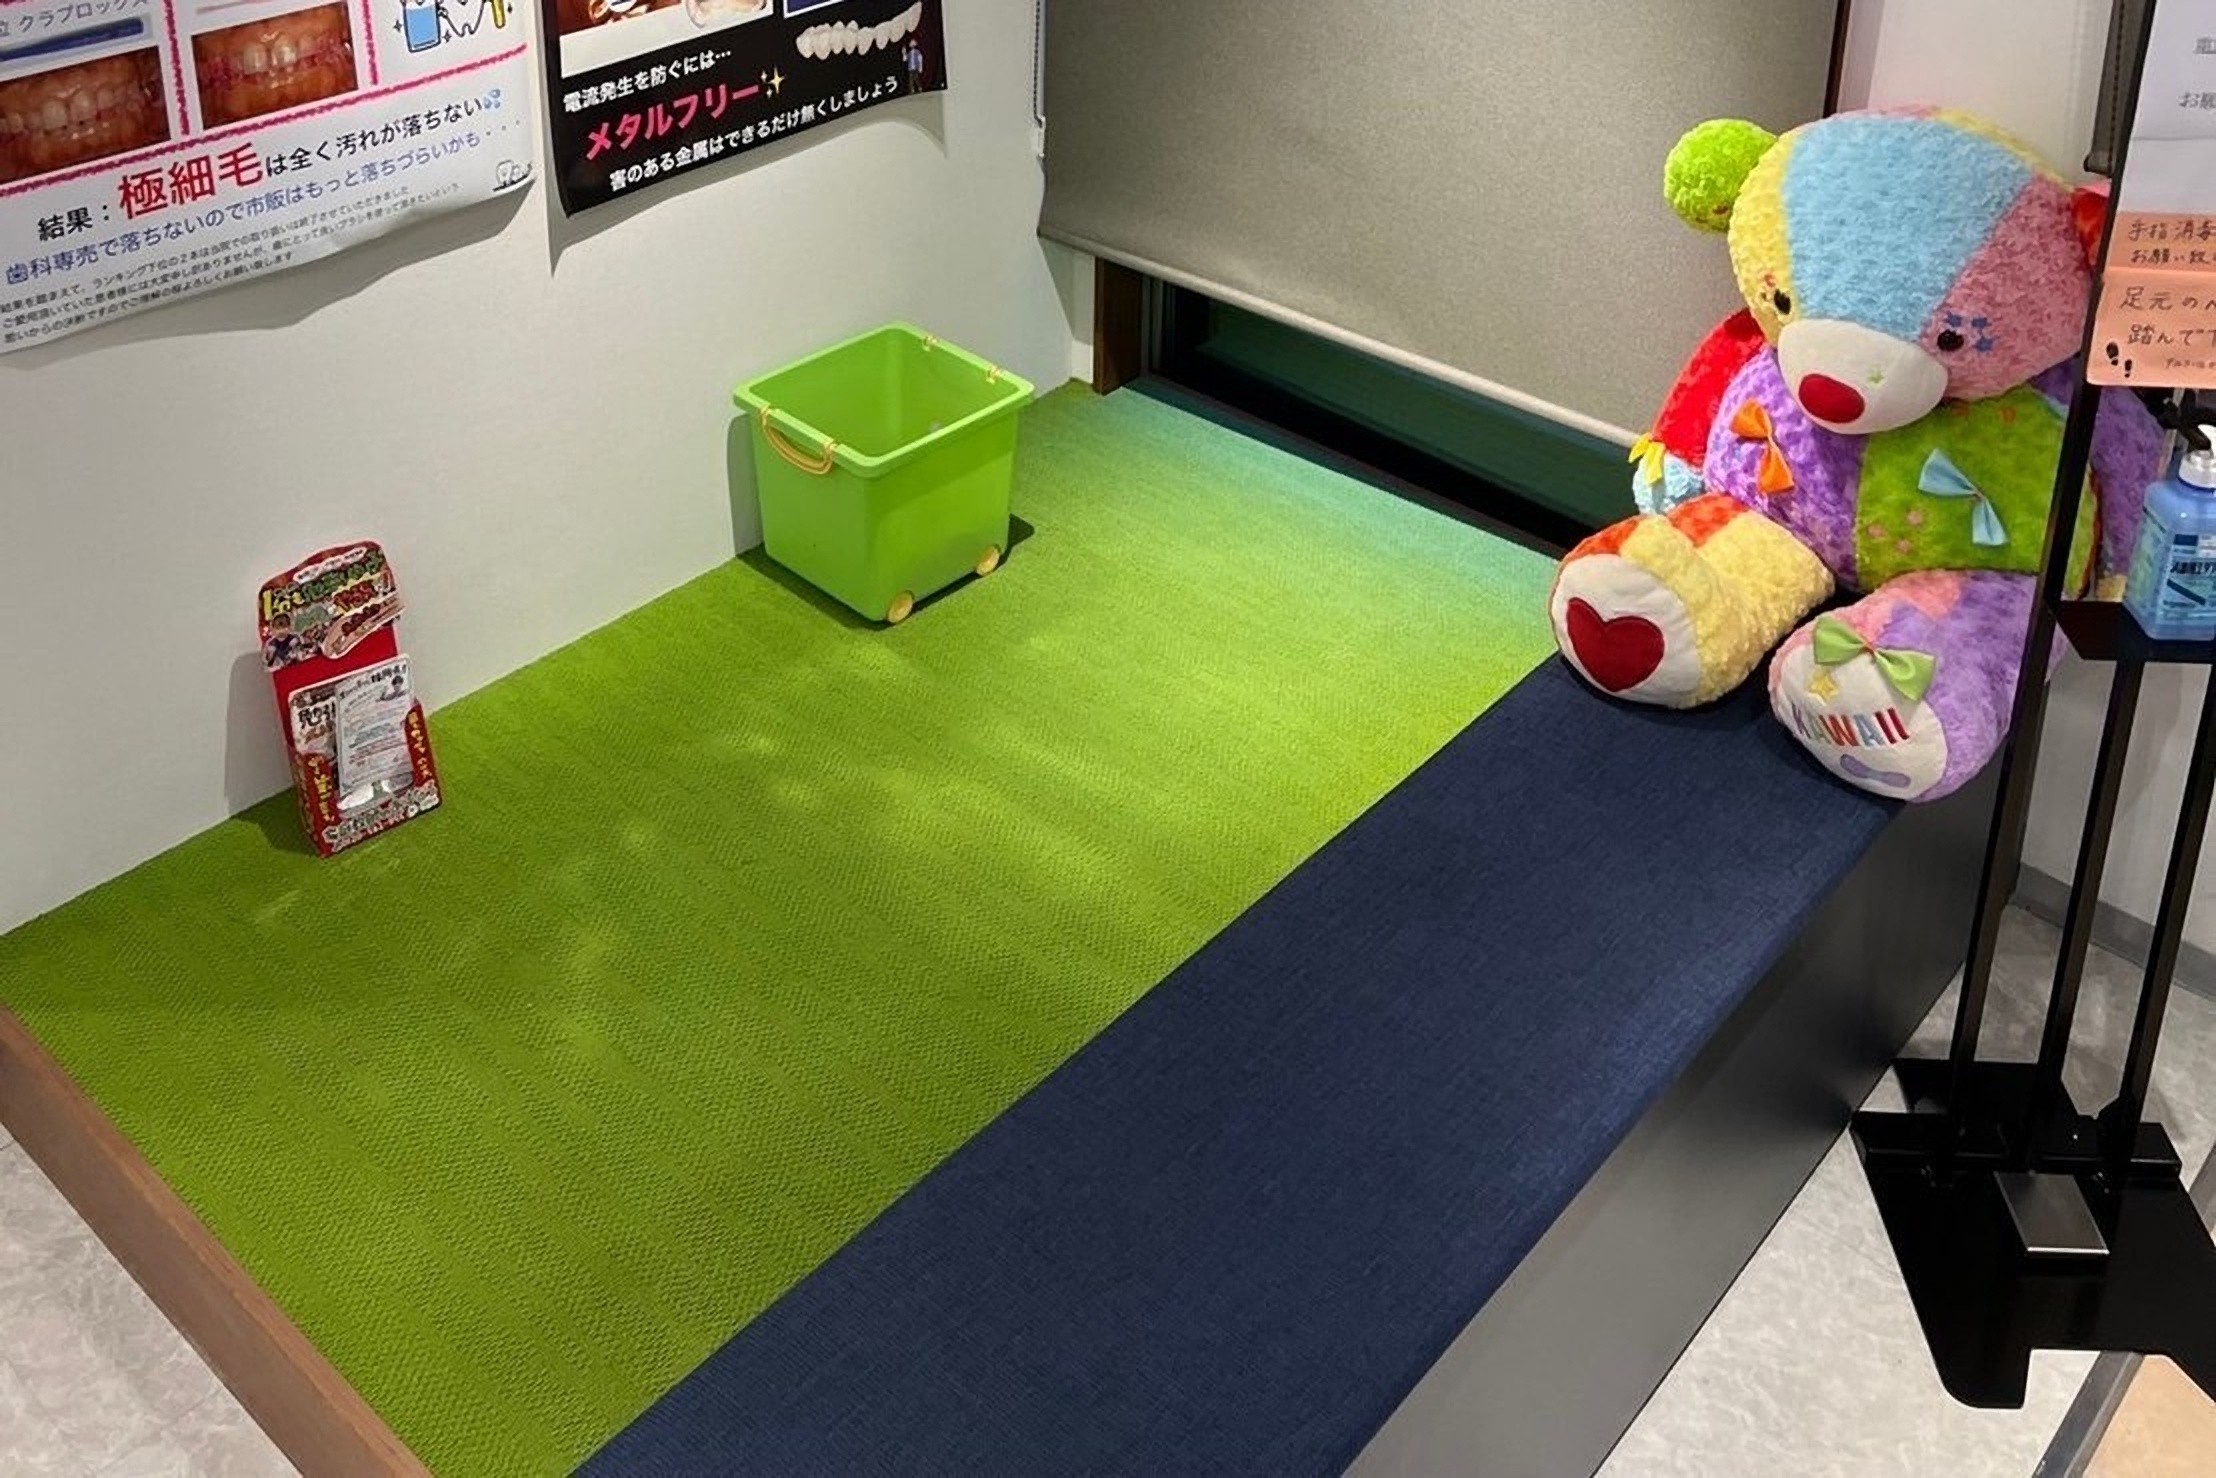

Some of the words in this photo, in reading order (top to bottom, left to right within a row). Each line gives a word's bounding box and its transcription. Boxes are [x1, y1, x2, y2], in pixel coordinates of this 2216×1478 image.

[584, 83, 759, 160] メタルフリー
[609, 75, 899, 192] 害のある金属はできるだけ無くしましょう
[1791, 701, 1910, 747] KAWAII
